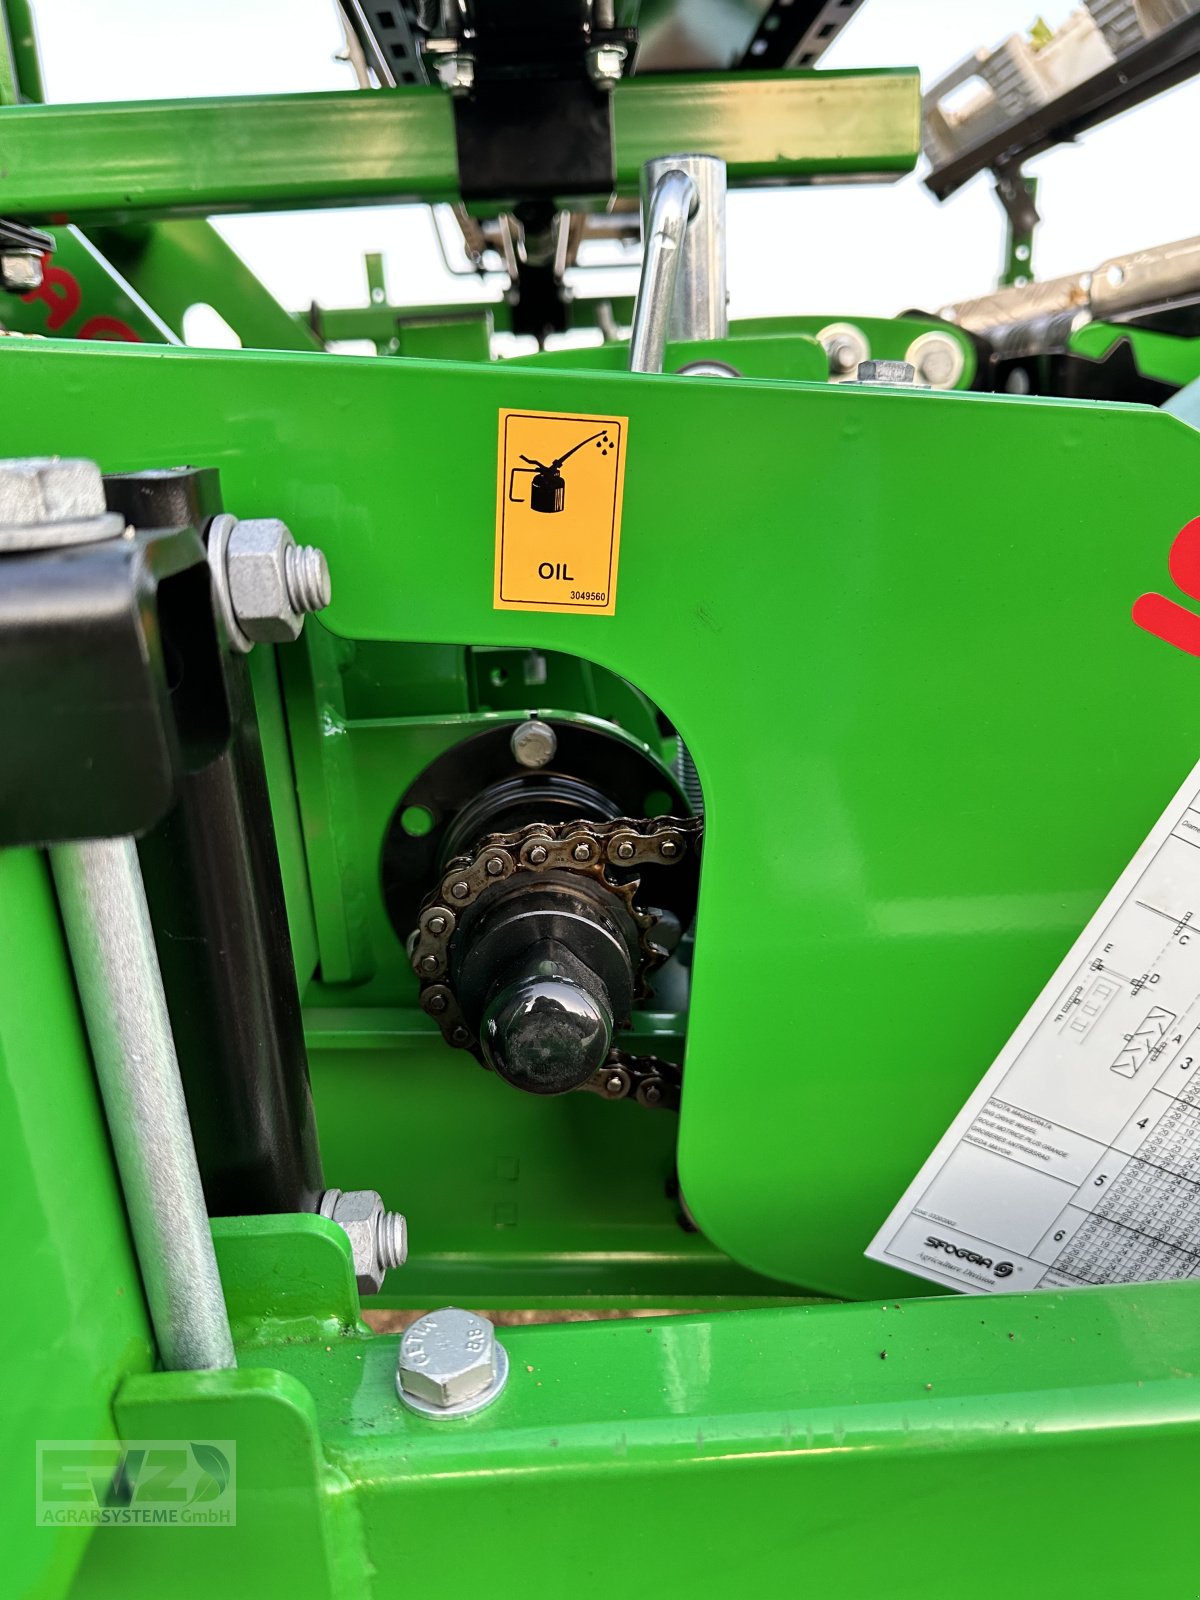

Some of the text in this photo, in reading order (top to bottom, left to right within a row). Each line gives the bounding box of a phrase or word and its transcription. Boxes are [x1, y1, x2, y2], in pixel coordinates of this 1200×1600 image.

[538, 562, 574, 580] OIL
[570, 591, 605, 601] 3049560
[1178, 935, 1190, 945] C
[1104, 943, 1114, 953] E
[1149, 974, 1160, 984] D
[1172, 1034, 1182, 1044] A
[1180, 1057, 1193, 1070] 3
[1136, 1118, 1149, 1129] 4
[1094, 1175, 1107, 1186] 5
[1054, 1230, 1066, 1241] 6
[924, 1236, 993, 1269] SFOGGIA
[917, 1252, 996, 1285] Agriculture Division
